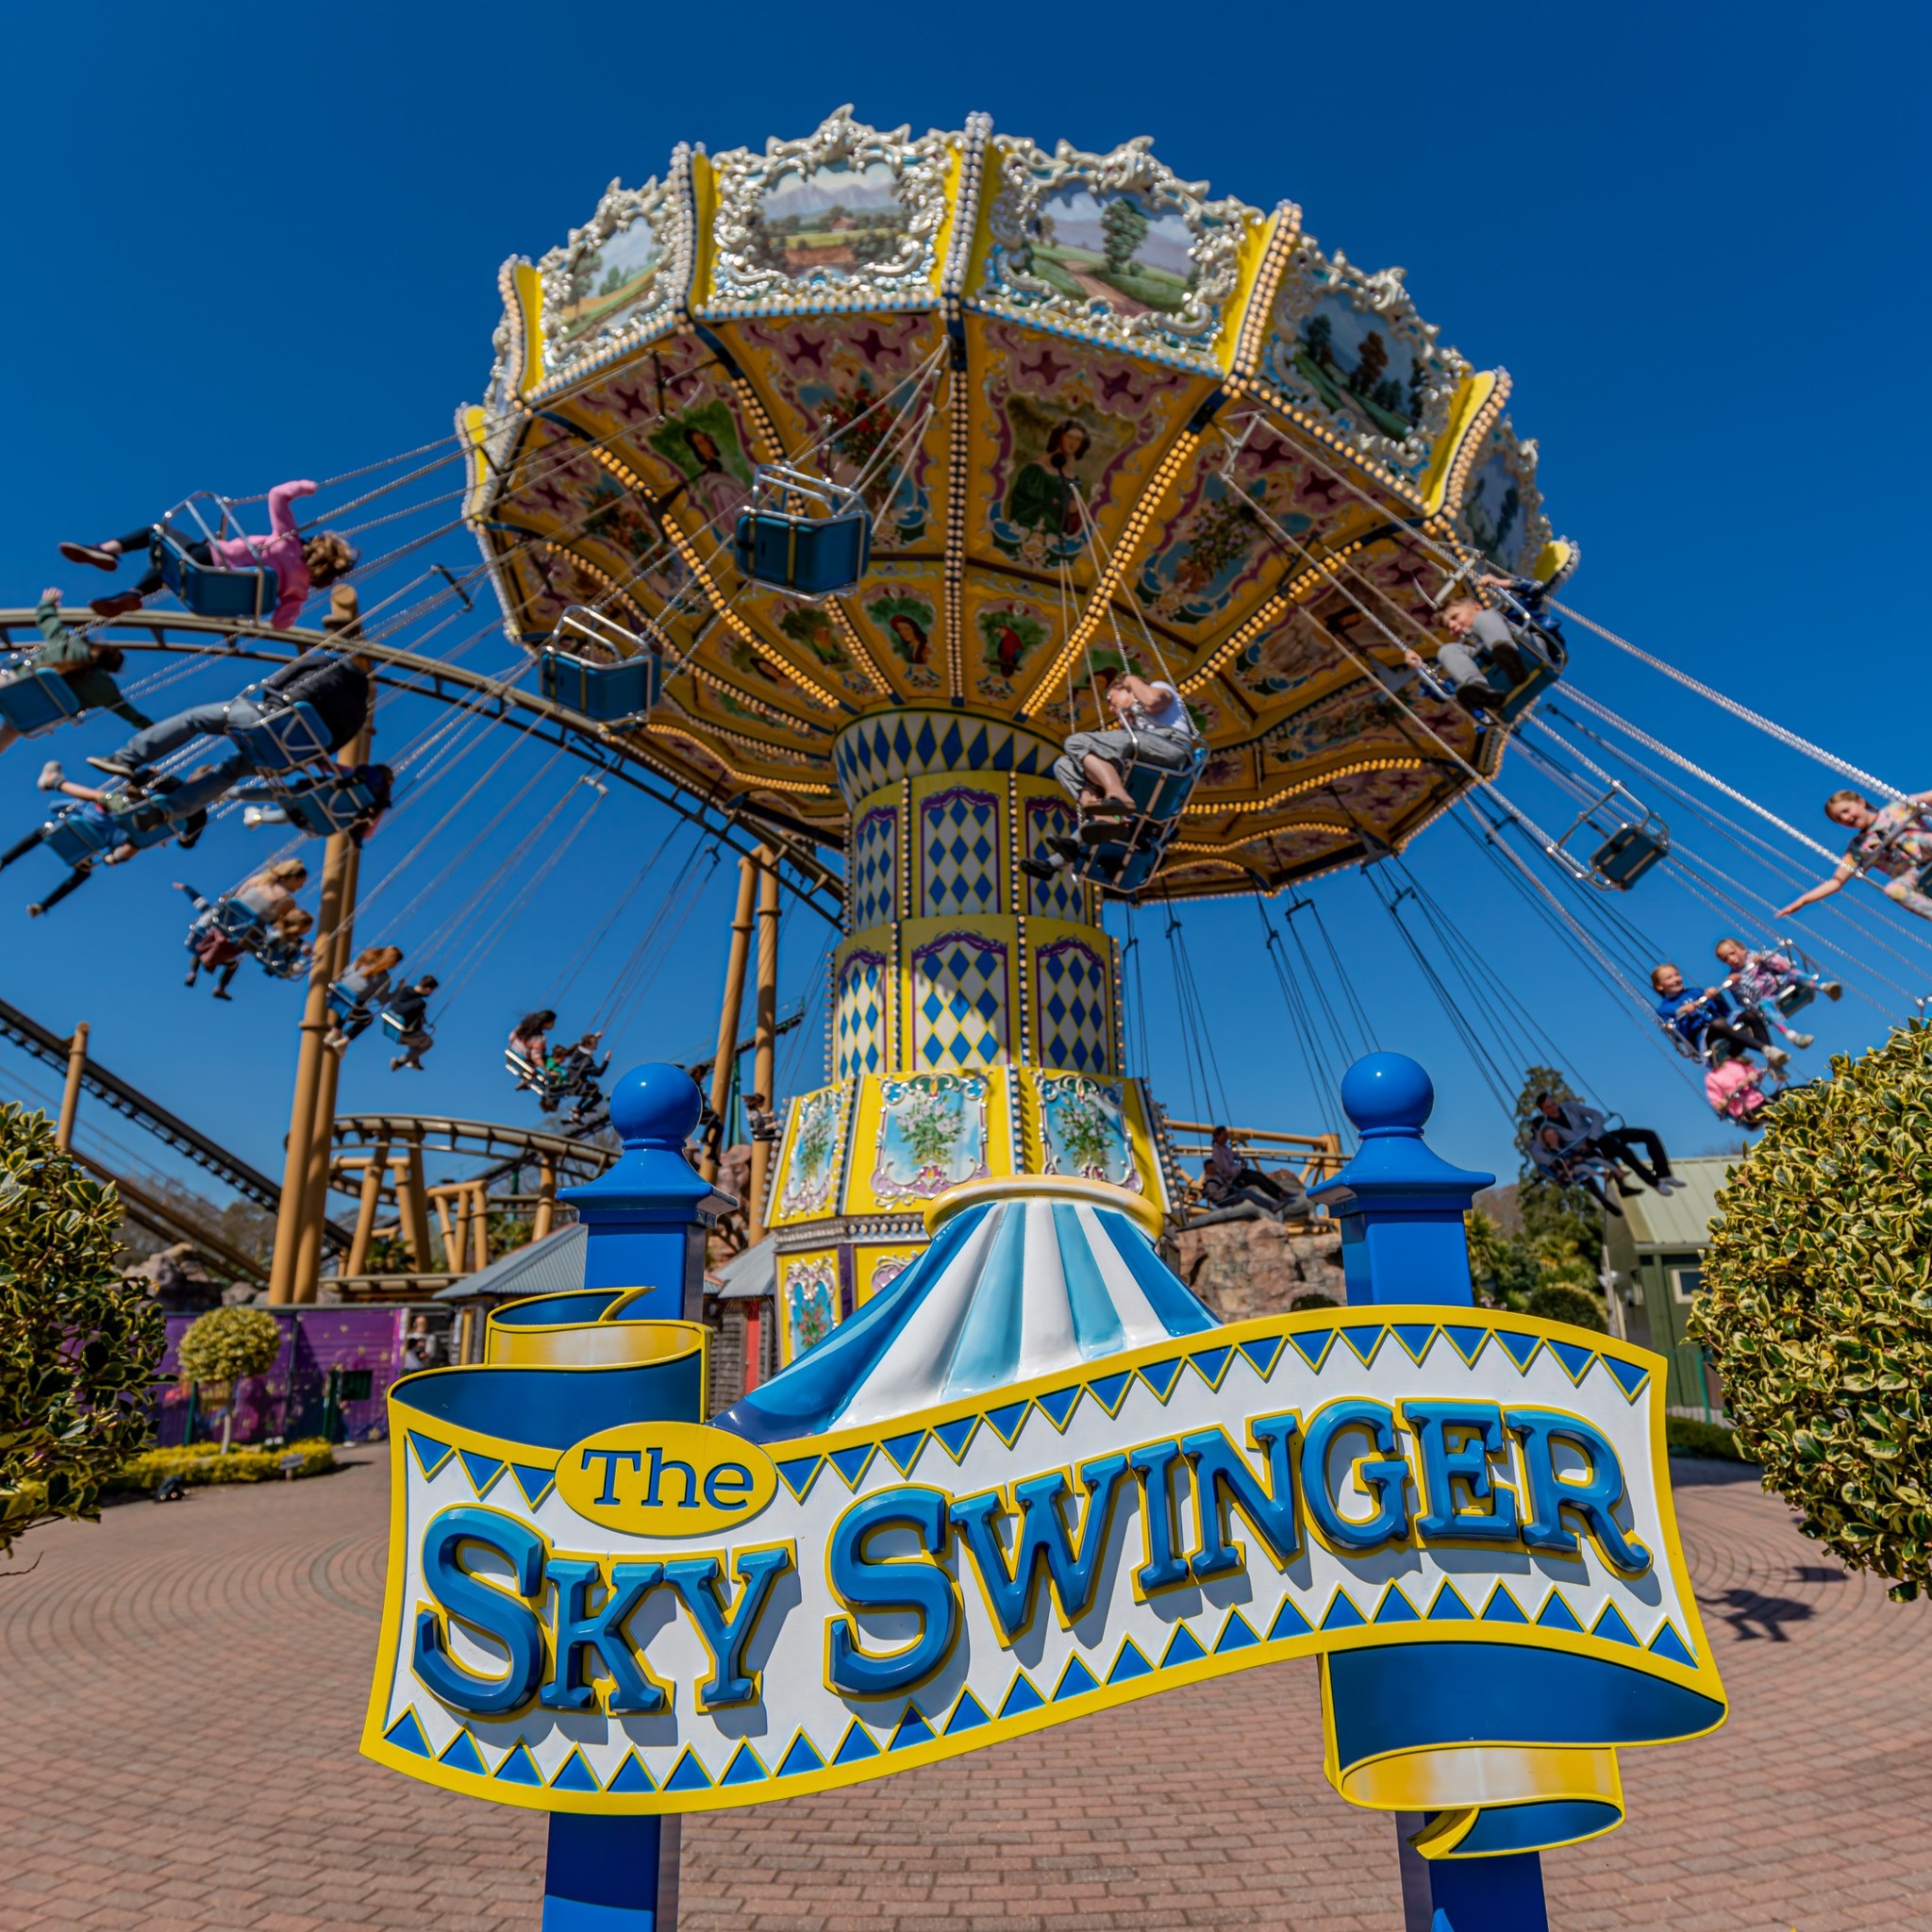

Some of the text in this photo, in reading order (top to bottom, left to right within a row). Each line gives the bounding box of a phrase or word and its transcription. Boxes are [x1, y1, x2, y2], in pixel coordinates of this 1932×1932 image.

[411, 1400, 1653, 1716] SKY SWINGER
[581, 1447, 755, 1509] The
